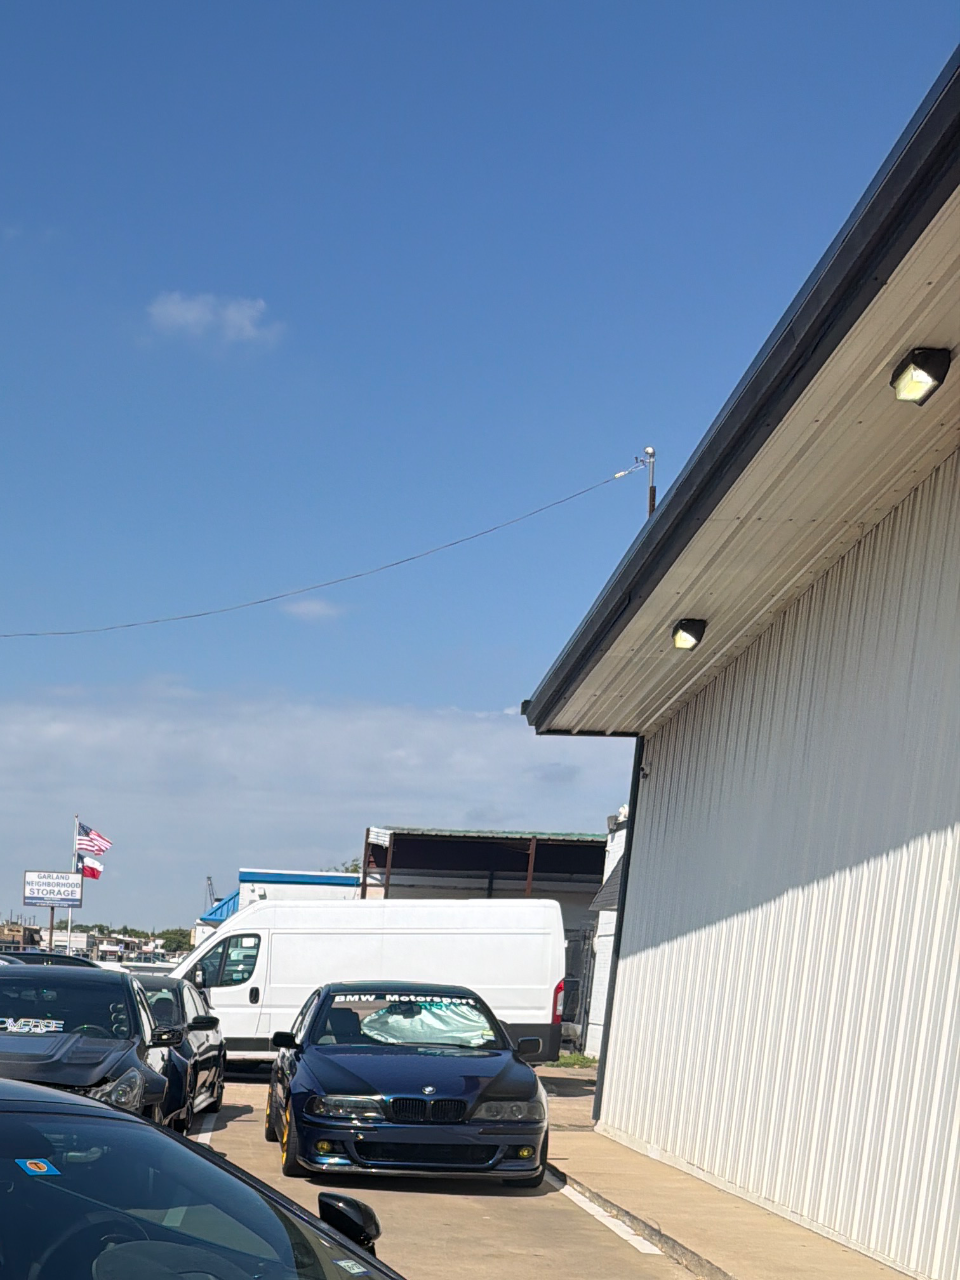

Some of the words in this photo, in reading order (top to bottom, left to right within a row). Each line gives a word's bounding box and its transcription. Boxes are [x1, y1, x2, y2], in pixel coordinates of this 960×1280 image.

[26, 880, 81, 888] NEIGHBORHOOD
[29, 888, 77, 898] STORAGE
[385, 995, 475, 1005] Motorsport
